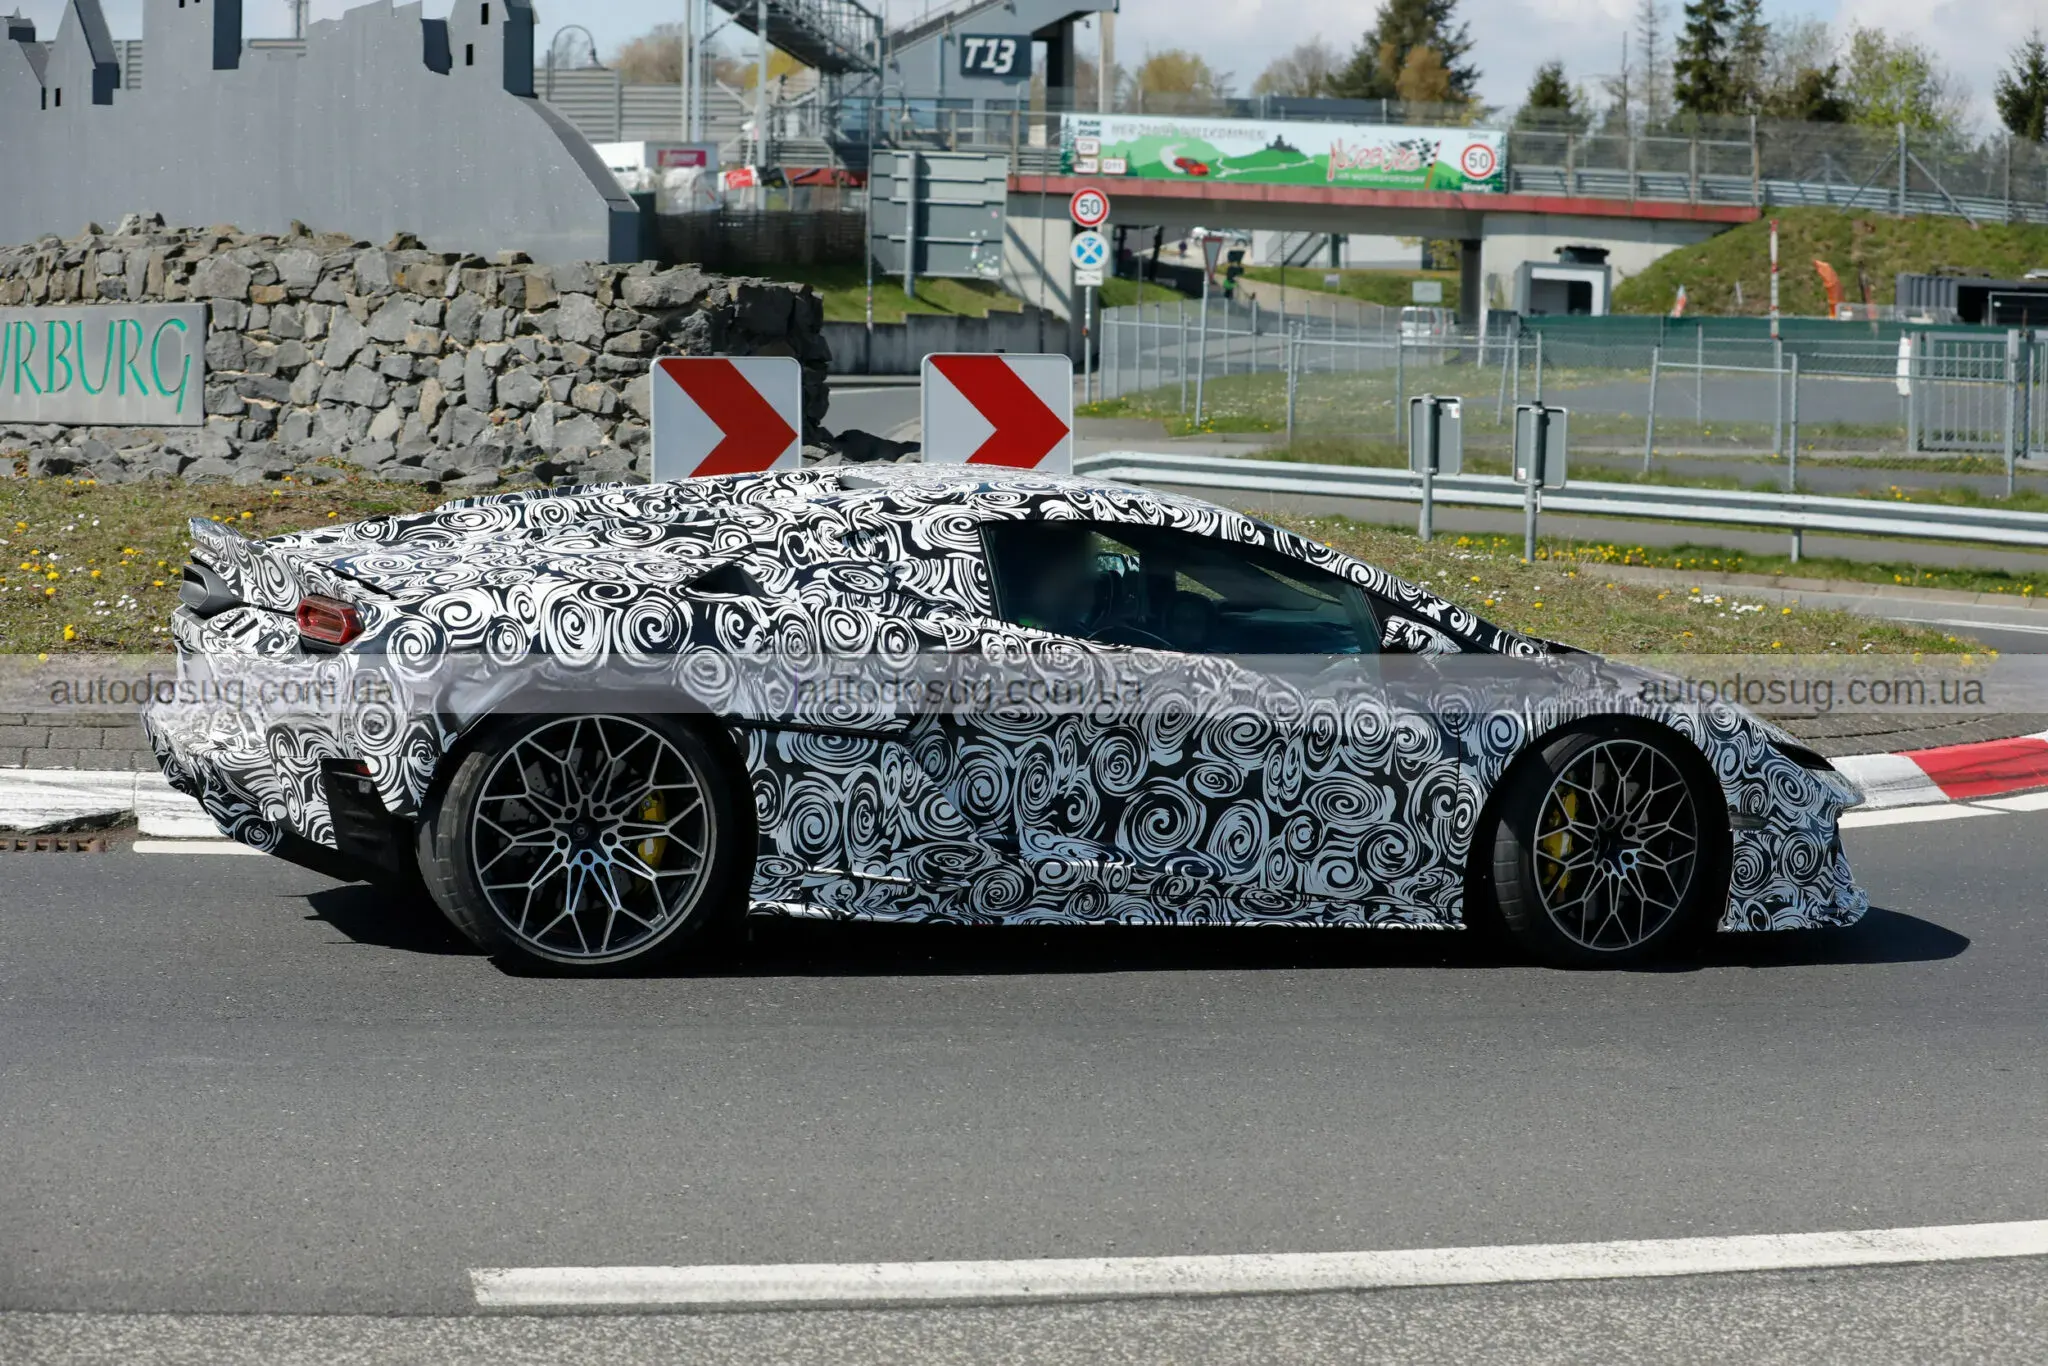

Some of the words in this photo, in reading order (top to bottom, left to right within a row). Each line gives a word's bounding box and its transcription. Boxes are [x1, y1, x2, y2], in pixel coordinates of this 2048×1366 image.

[964, 38, 1016, 74] T13
[1468, 152, 1489, 169] 50
[1080, 199, 1101, 215] 50
[0, 318, 191, 414] RBURG
